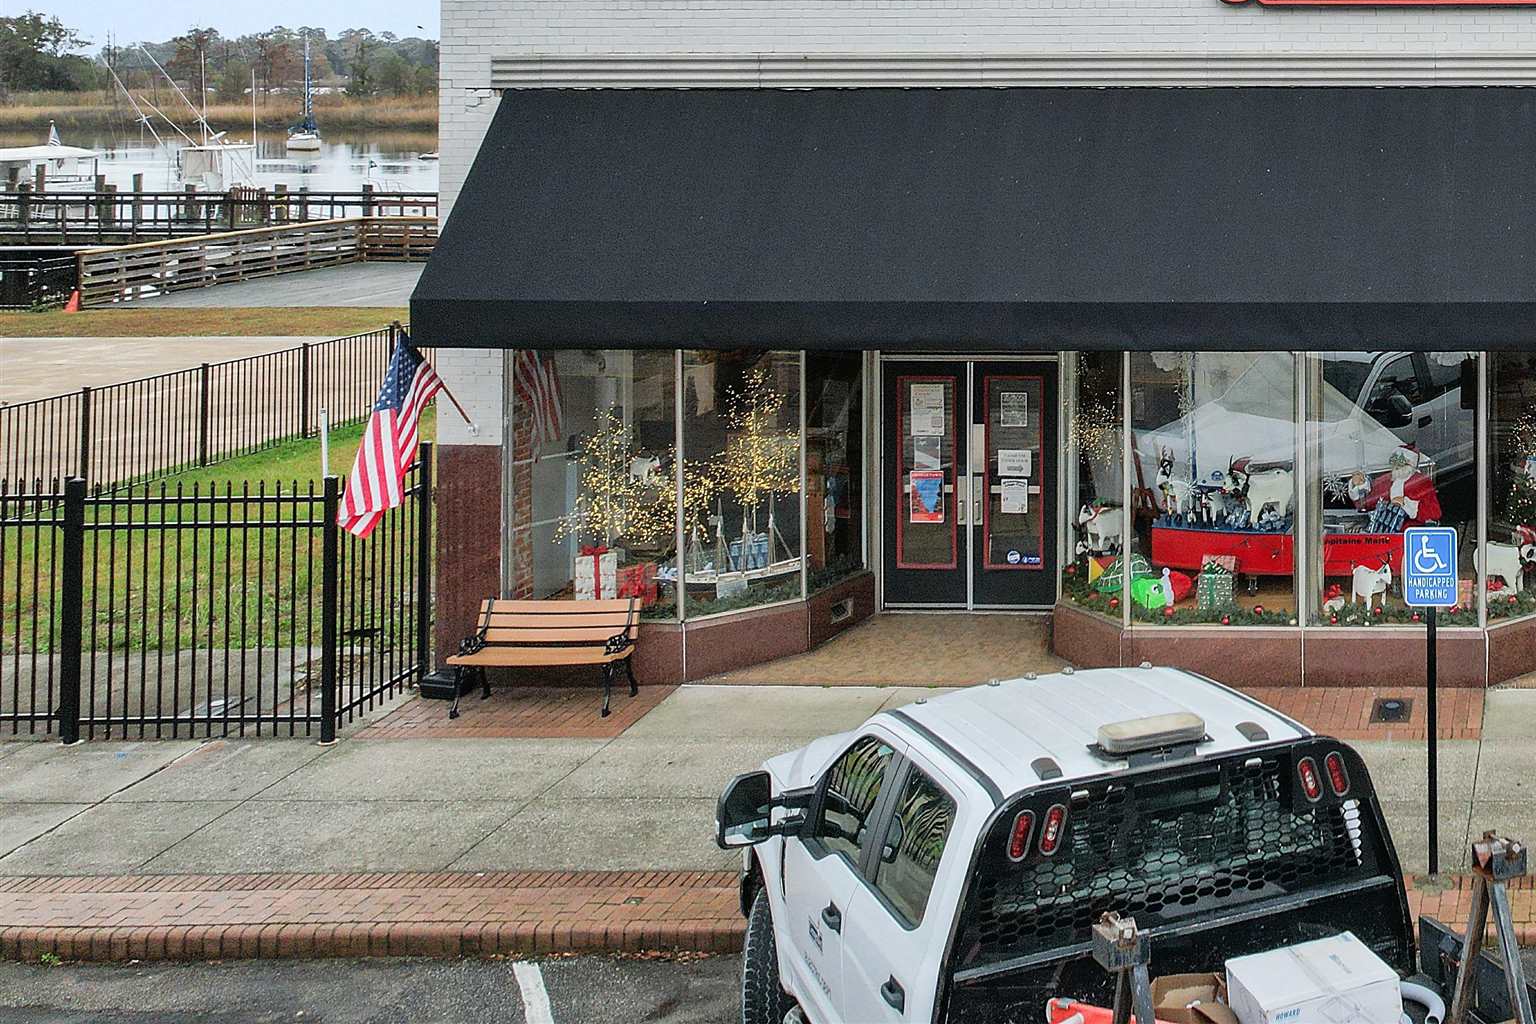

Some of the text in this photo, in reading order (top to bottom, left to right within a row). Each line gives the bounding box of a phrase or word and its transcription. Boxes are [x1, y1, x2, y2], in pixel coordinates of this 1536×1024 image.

[1408, 577, 1455, 587] HANDICAPPED
[1415, 588, 1448, 600] PARKING
[1275, 1007, 1301, 1021] HOWARD
